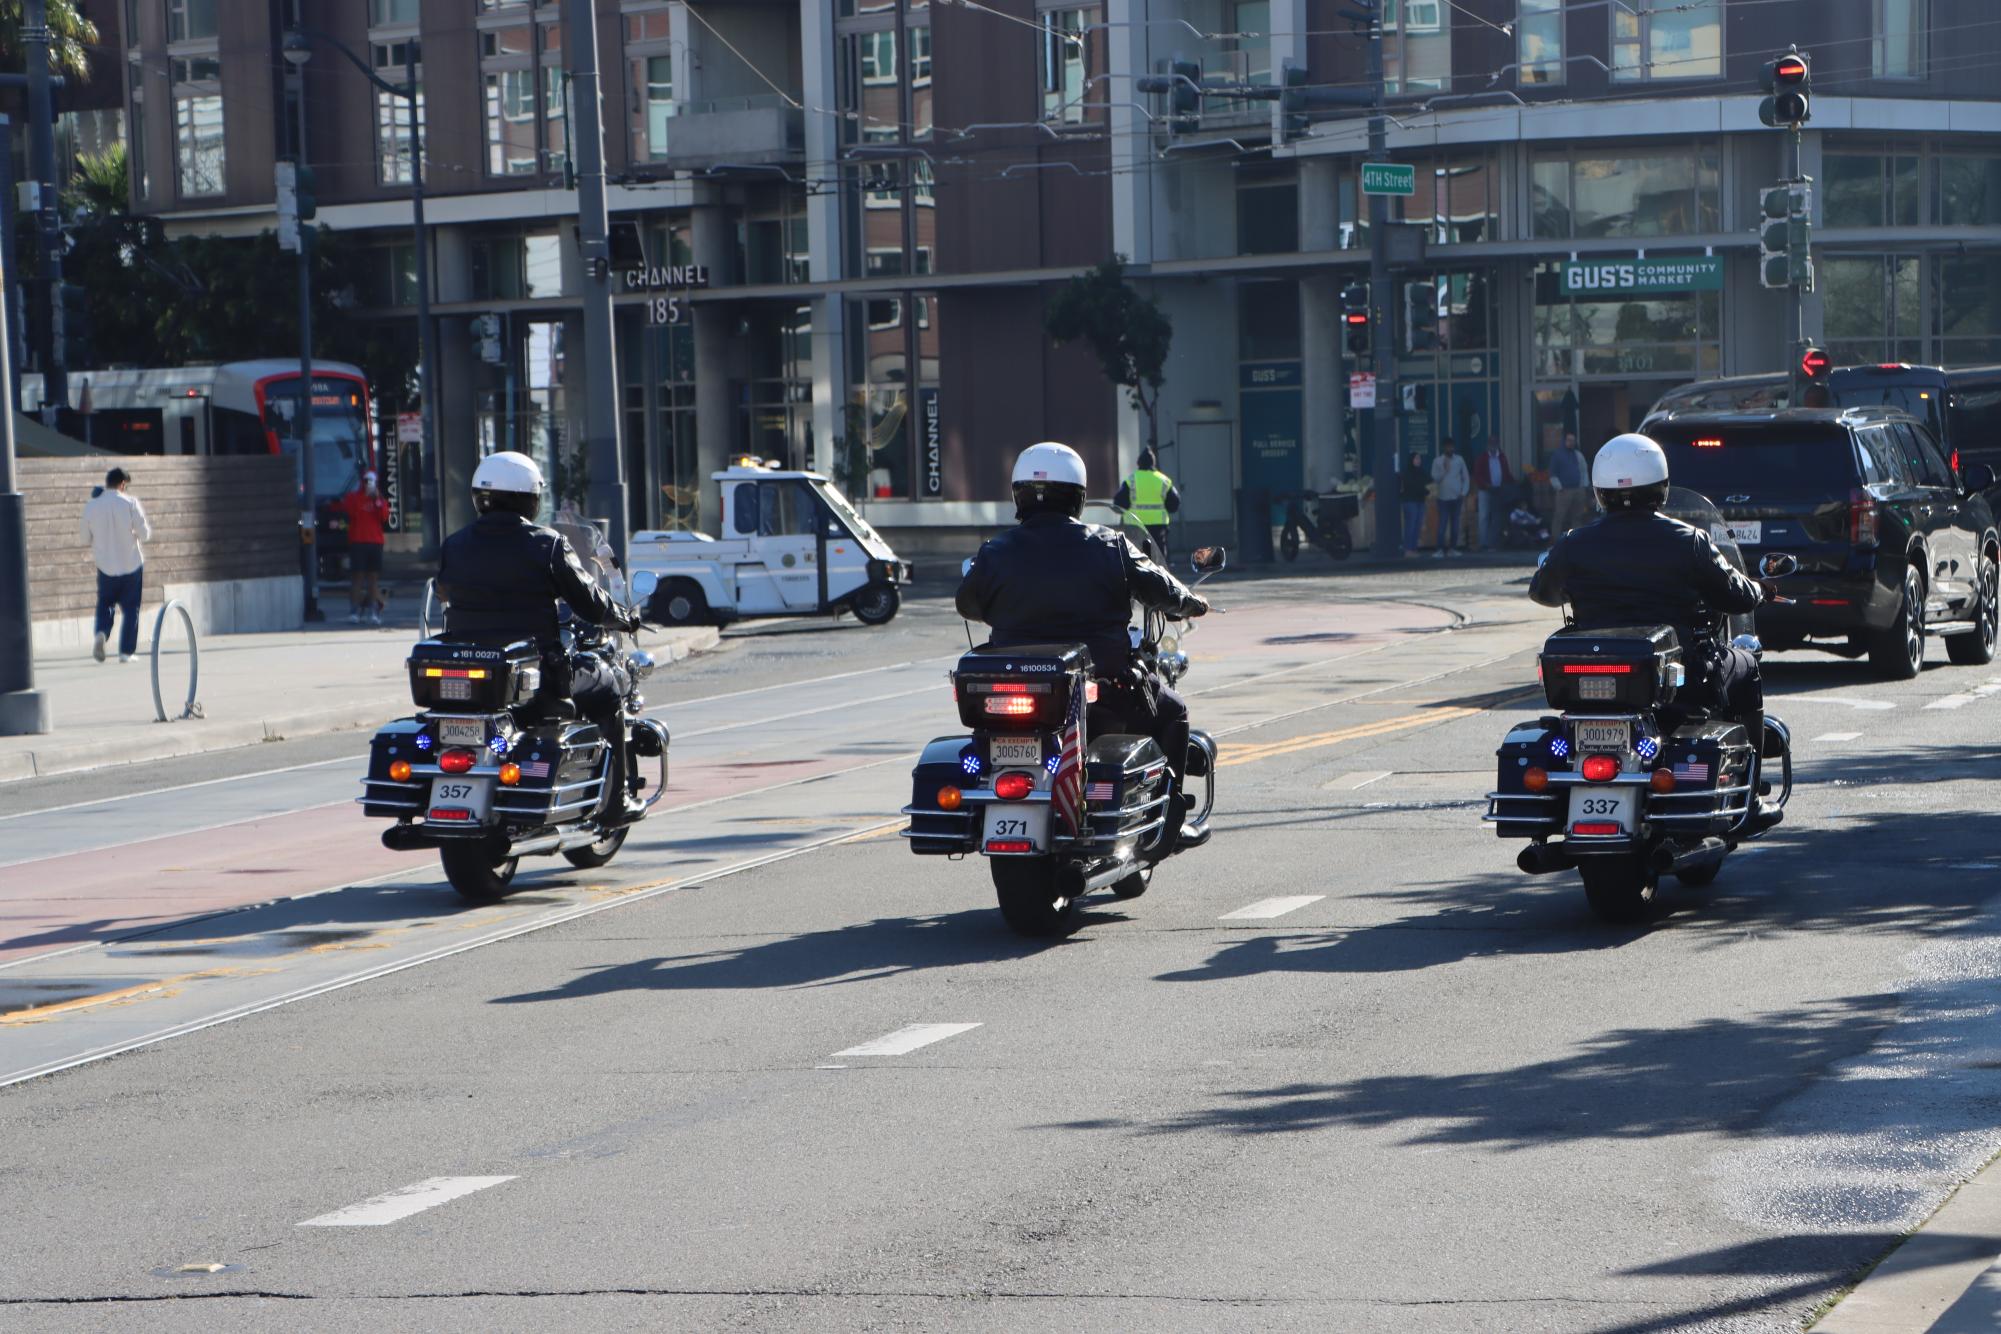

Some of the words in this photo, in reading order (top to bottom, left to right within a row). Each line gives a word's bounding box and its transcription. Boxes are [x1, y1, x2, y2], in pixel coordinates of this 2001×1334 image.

[1364, 171, 1382, 187] 4TH
[1384, 172, 1413, 189] Street
[626, 264, 707, 288] CHANNEL
[1567, 265, 1635, 289] GUS'S
[1638, 263, 1717, 276] COMMUNITY
[1638, 274, 1694, 286] MARKET
[648, 297, 679, 324] 185
[926, 392, 940, 492] CHANNEL
[385, 424, 399, 530] CHANNEL
[1583, 728, 1624, 741] 3001979
[996, 745, 1037, 758] 3005760
[440, 785, 472, 799] 357
[1582, 799, 1620, 815] 337
[995, 820, 1027, 835] 371
